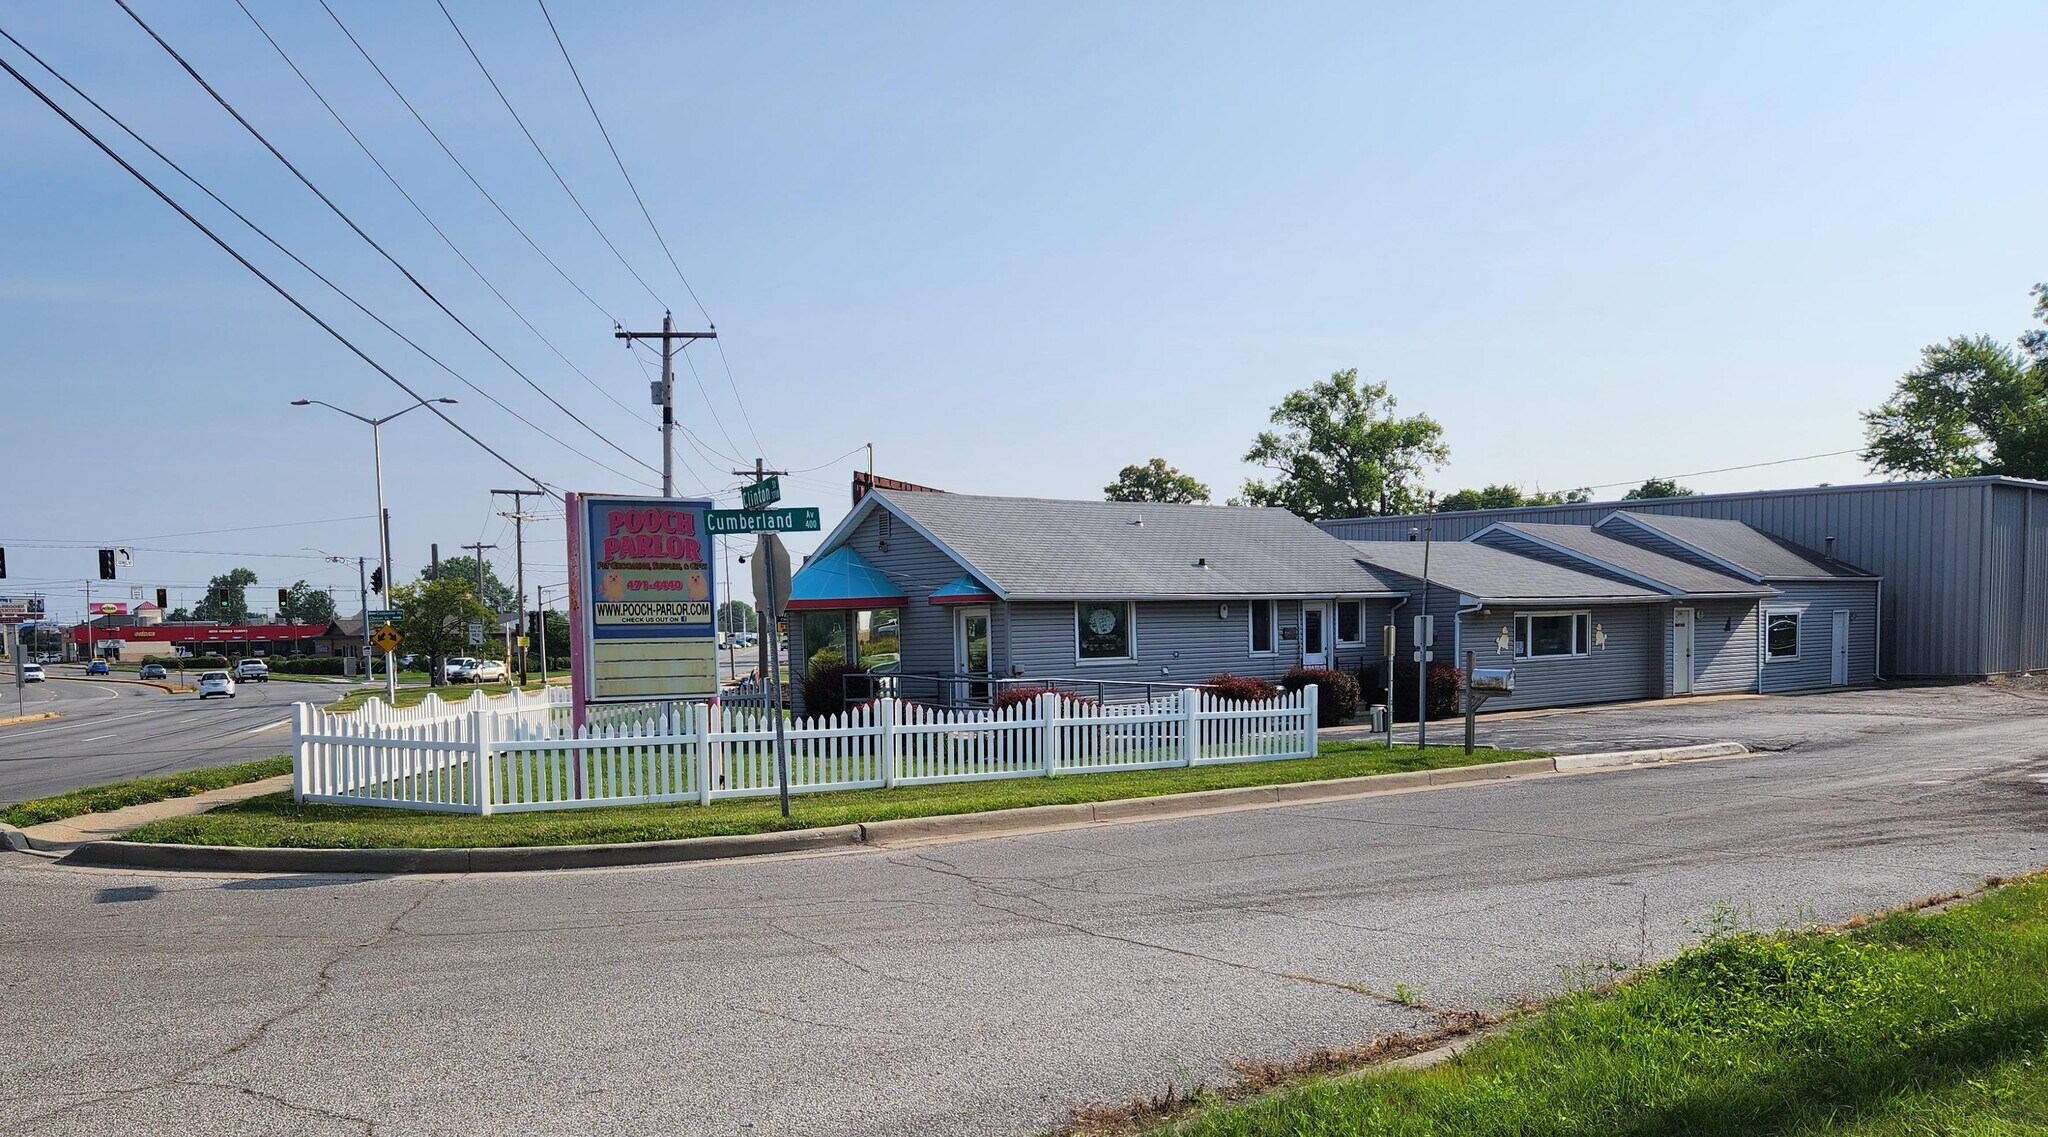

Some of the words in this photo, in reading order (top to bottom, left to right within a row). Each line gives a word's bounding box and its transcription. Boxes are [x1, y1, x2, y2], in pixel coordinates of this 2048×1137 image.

[743, 487, 771, 508] Clinton
[607, 508, 695, 536] POOCH
[707, 512, 793, 531] Cumberland
[806, 510, 814, 519] Av
[805, 520, 817, 529] 400
[603, 534, 703, 562] PARLOR
[626, 580, 684, 591] 471-4440
[596, 603, 710, 616] WWW.POOCH-PARLOR.COM
